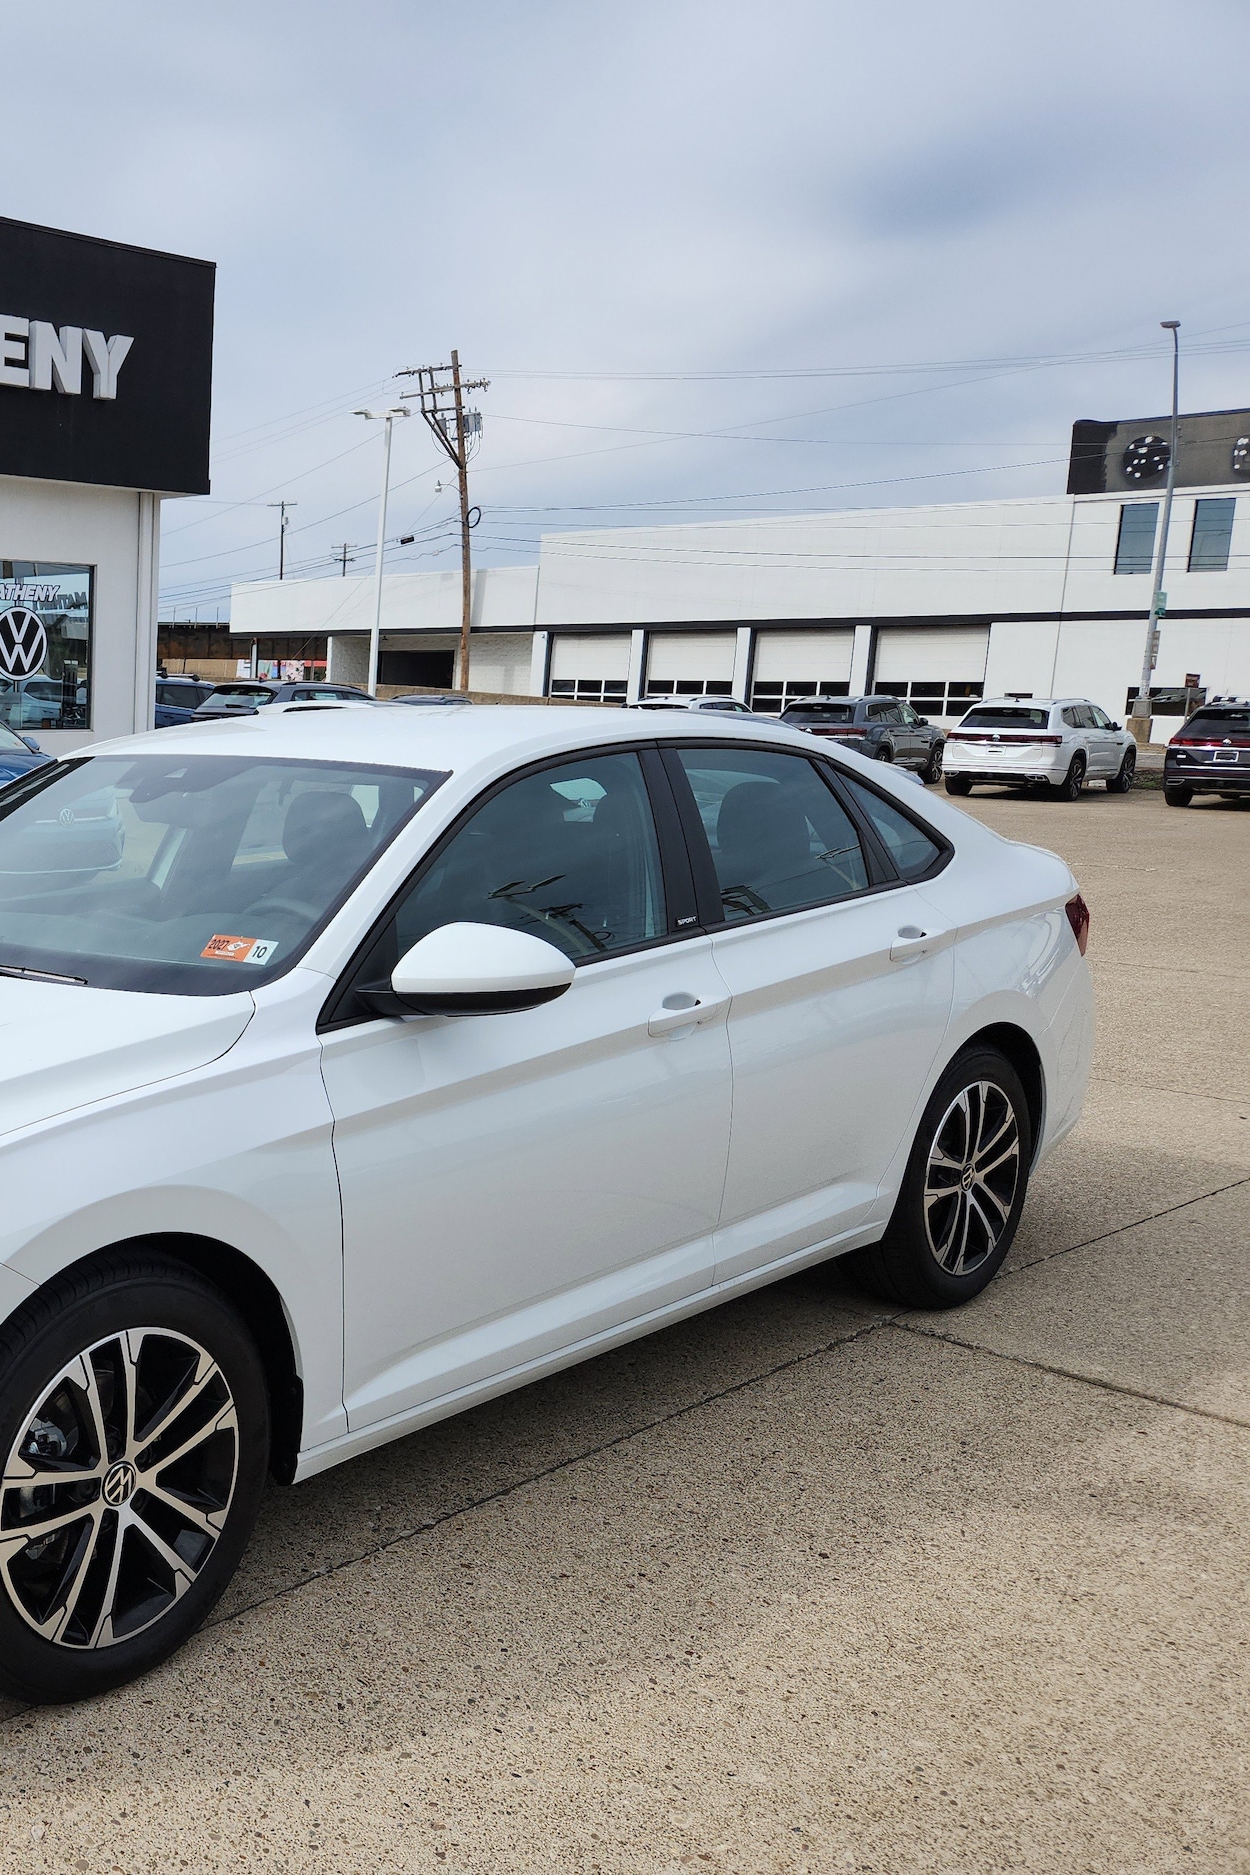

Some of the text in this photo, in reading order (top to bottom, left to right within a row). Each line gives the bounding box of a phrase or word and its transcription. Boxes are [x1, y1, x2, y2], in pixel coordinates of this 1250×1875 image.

[677, 916, 697, 926] SPORT
[208, 939, 230, 951] 2027
[252, 945, 268, 959] 10
